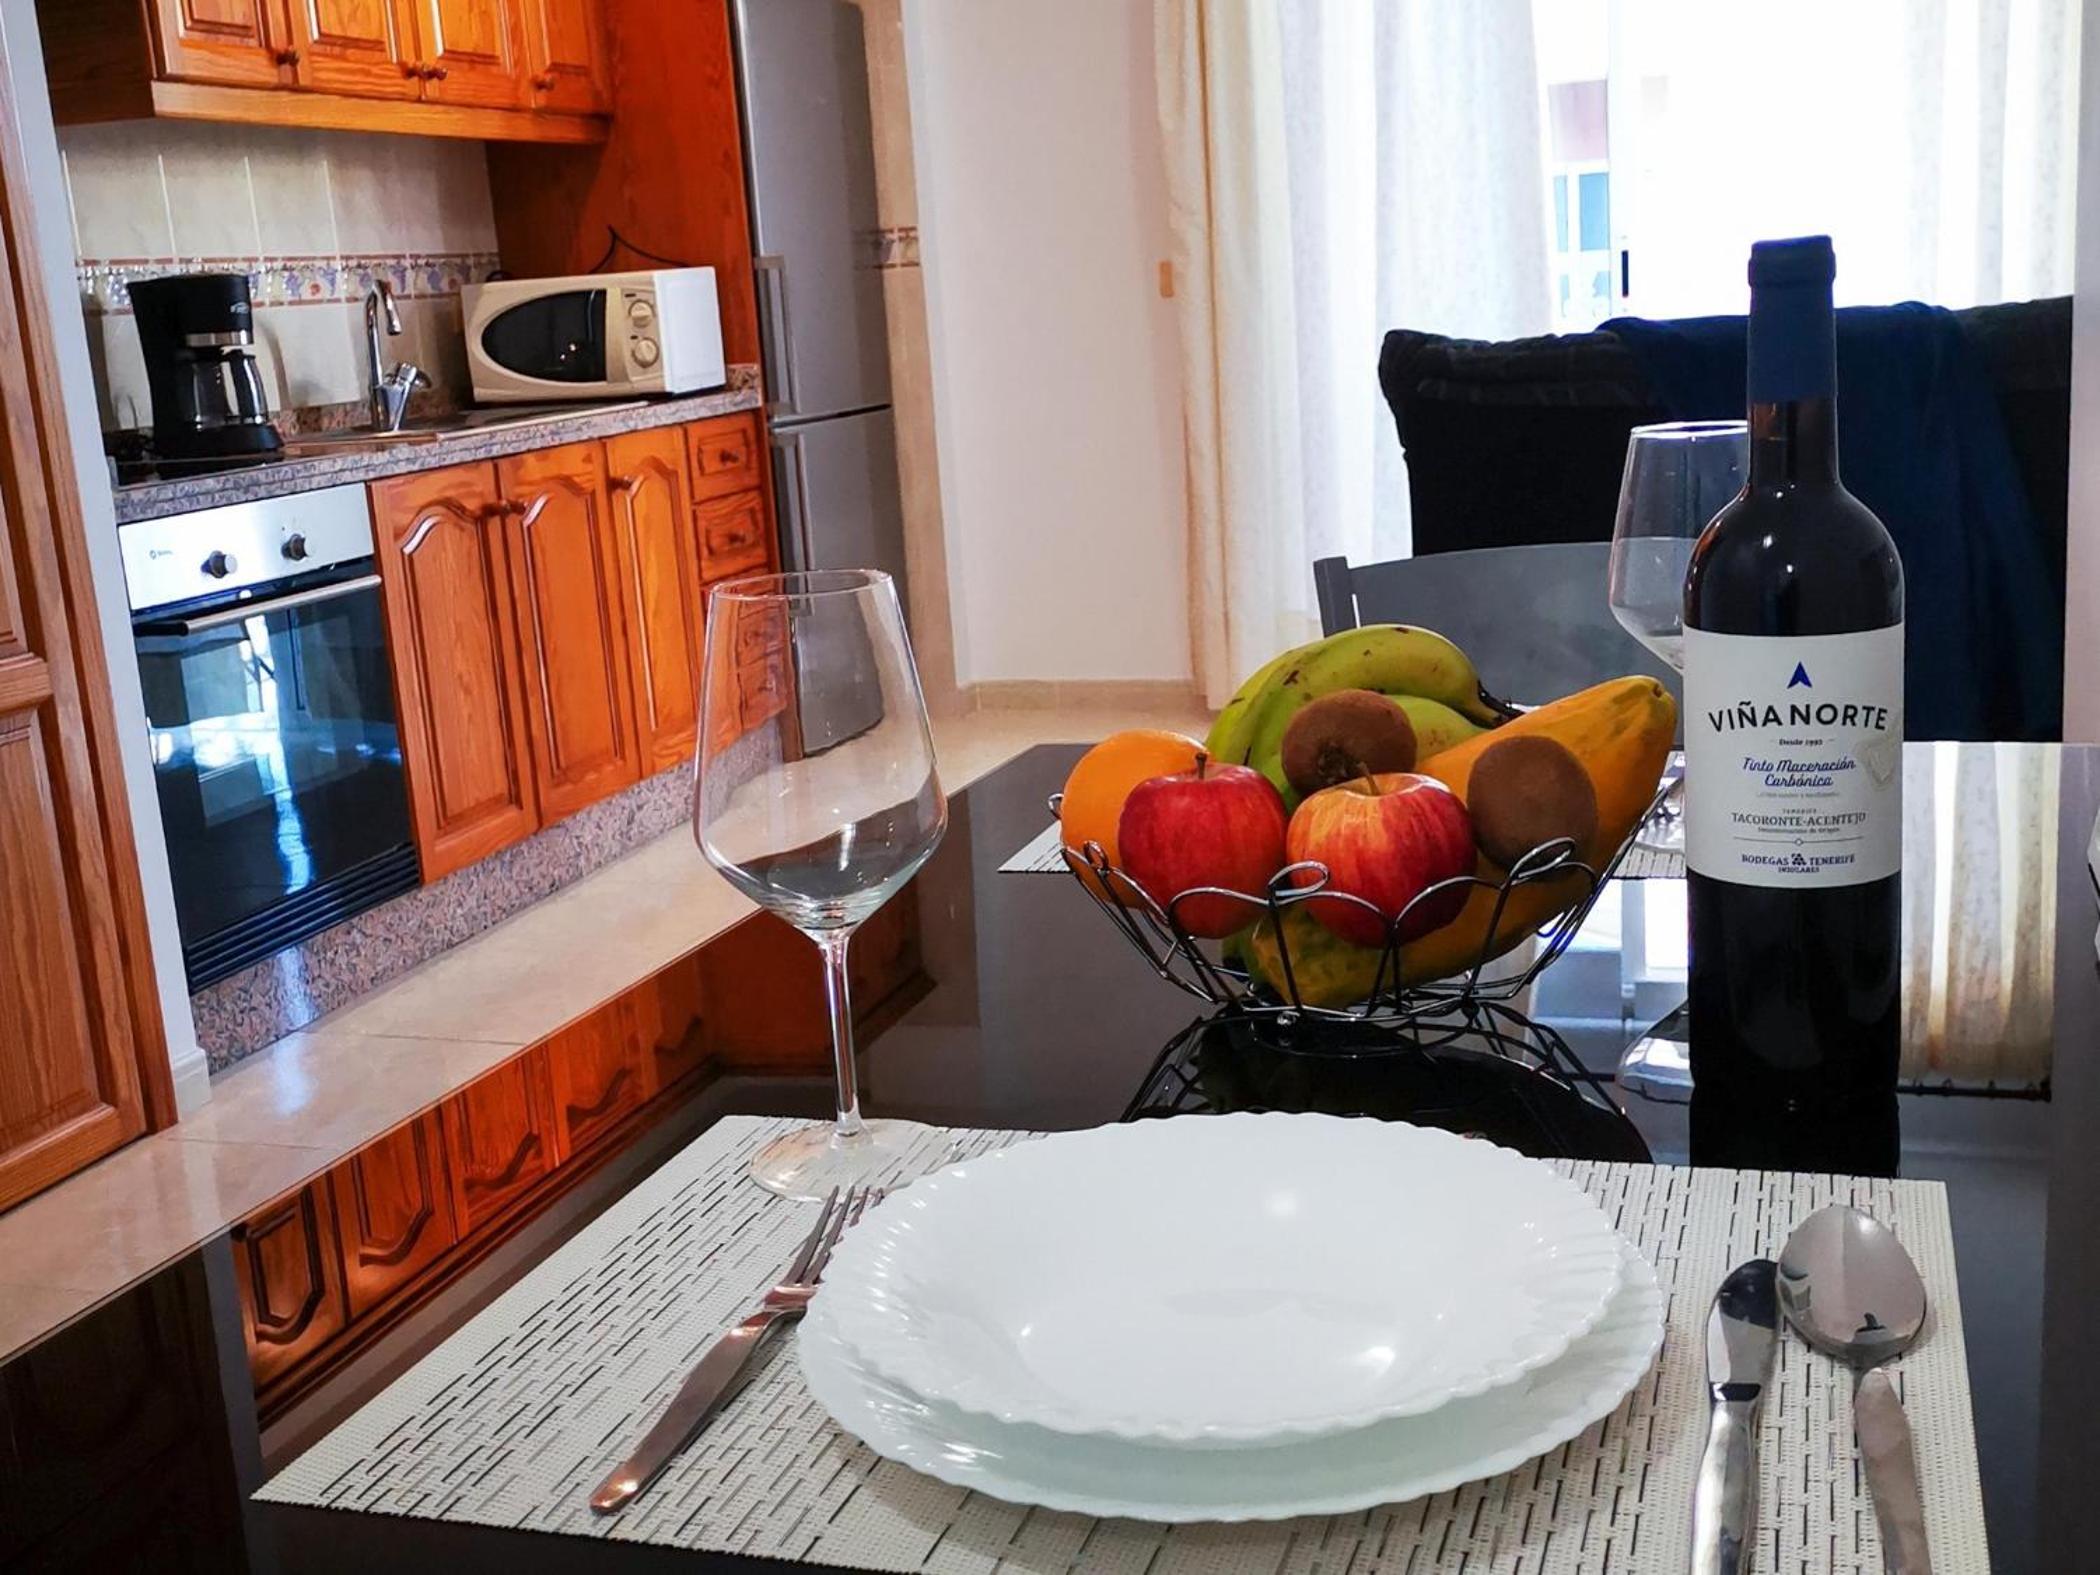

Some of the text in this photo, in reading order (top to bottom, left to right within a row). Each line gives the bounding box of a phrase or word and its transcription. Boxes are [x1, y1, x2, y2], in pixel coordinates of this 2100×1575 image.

[1743, 757, 1856, 772] Tinto Maceración
[1765, 773, 1833, 788] Carbónica
[1742, 854, 1790, 866] BODEGAS
